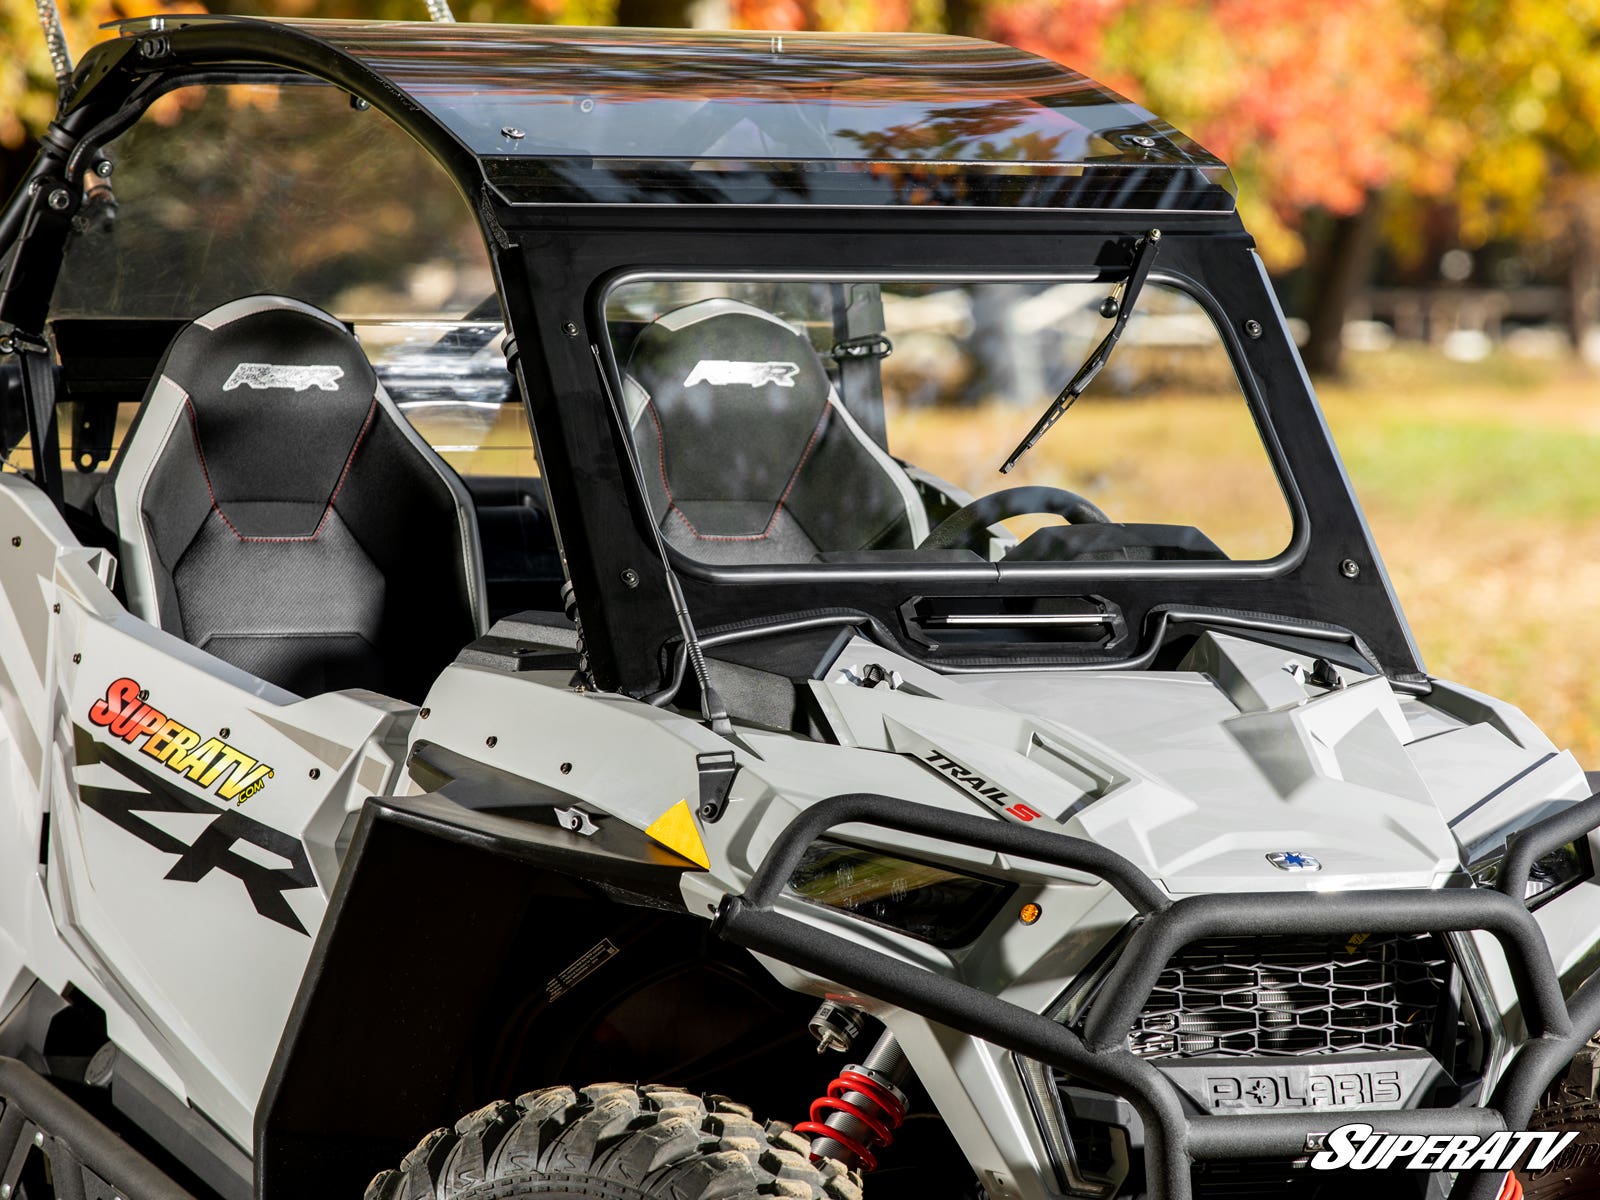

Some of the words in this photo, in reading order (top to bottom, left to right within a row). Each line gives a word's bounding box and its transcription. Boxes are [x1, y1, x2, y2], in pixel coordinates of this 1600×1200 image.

[924, 749, 1009, 807] TRAIL
[1004, 803, 1042, 822] S
[1206, 1070, 1402, 1109] POLARIS
